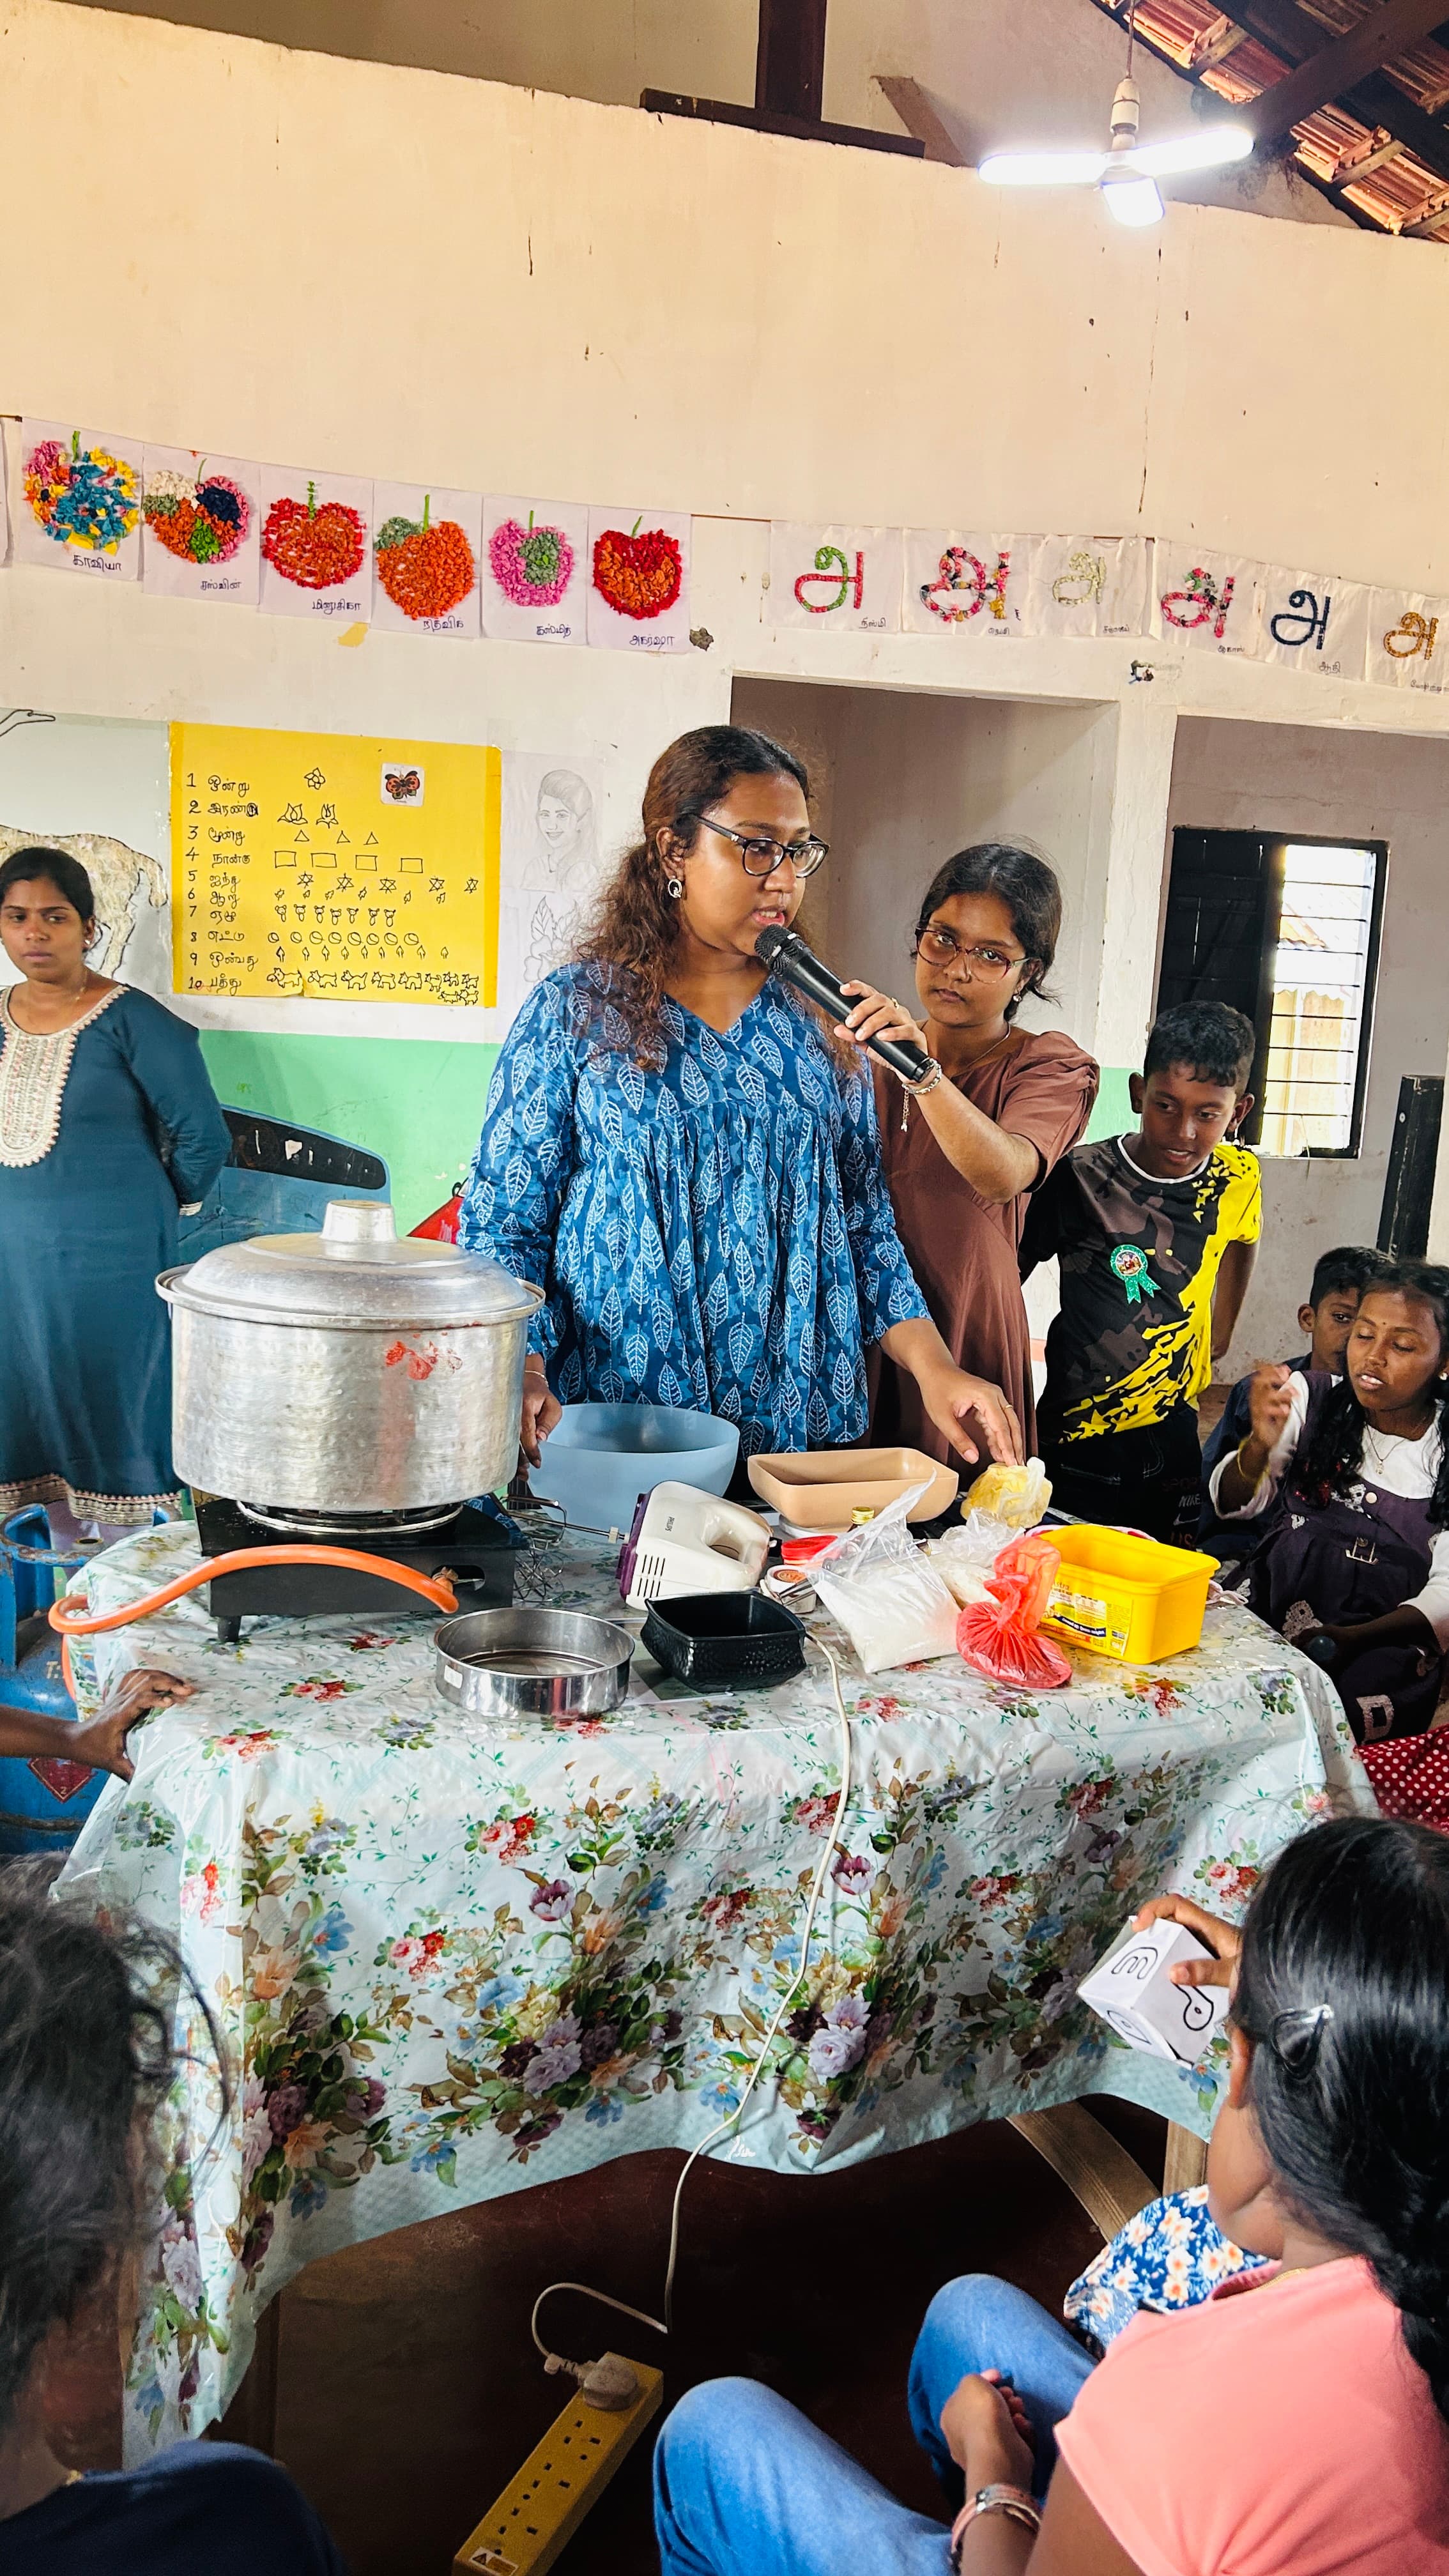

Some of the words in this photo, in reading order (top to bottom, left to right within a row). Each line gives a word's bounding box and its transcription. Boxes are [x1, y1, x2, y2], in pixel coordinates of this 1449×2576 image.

[795, 546, 864, 613] அ
[1271, 590, 1331, 650] அ
[1384, 611, 1439, 661] அ
[187, 772, 196, 788] 1
[208, 774, 250, 798] ஒன்று
[189, 800, 201, 814] 2
[187, 825, 199, 840] 3
[185, 847, 199, 862] 4
[211, 853, 250, 868] நான்கு
[188, 870, 197, 882] 5
[210, 871, 241, 893] ஐந்து
[188, 887, 195, 900] 6
[210, 891, 240, 909] ஆறு
[189, 905, 197, 917] 7
[190, 931, 197, 942] 8
[208, 930, 245, 942] எட்டு
[190, 952, 197, 966] 9
[188, 976, 202, 990] 10
[210, 972, 241, 996] பத்து
[61, 1786, 67, 1795] 2
